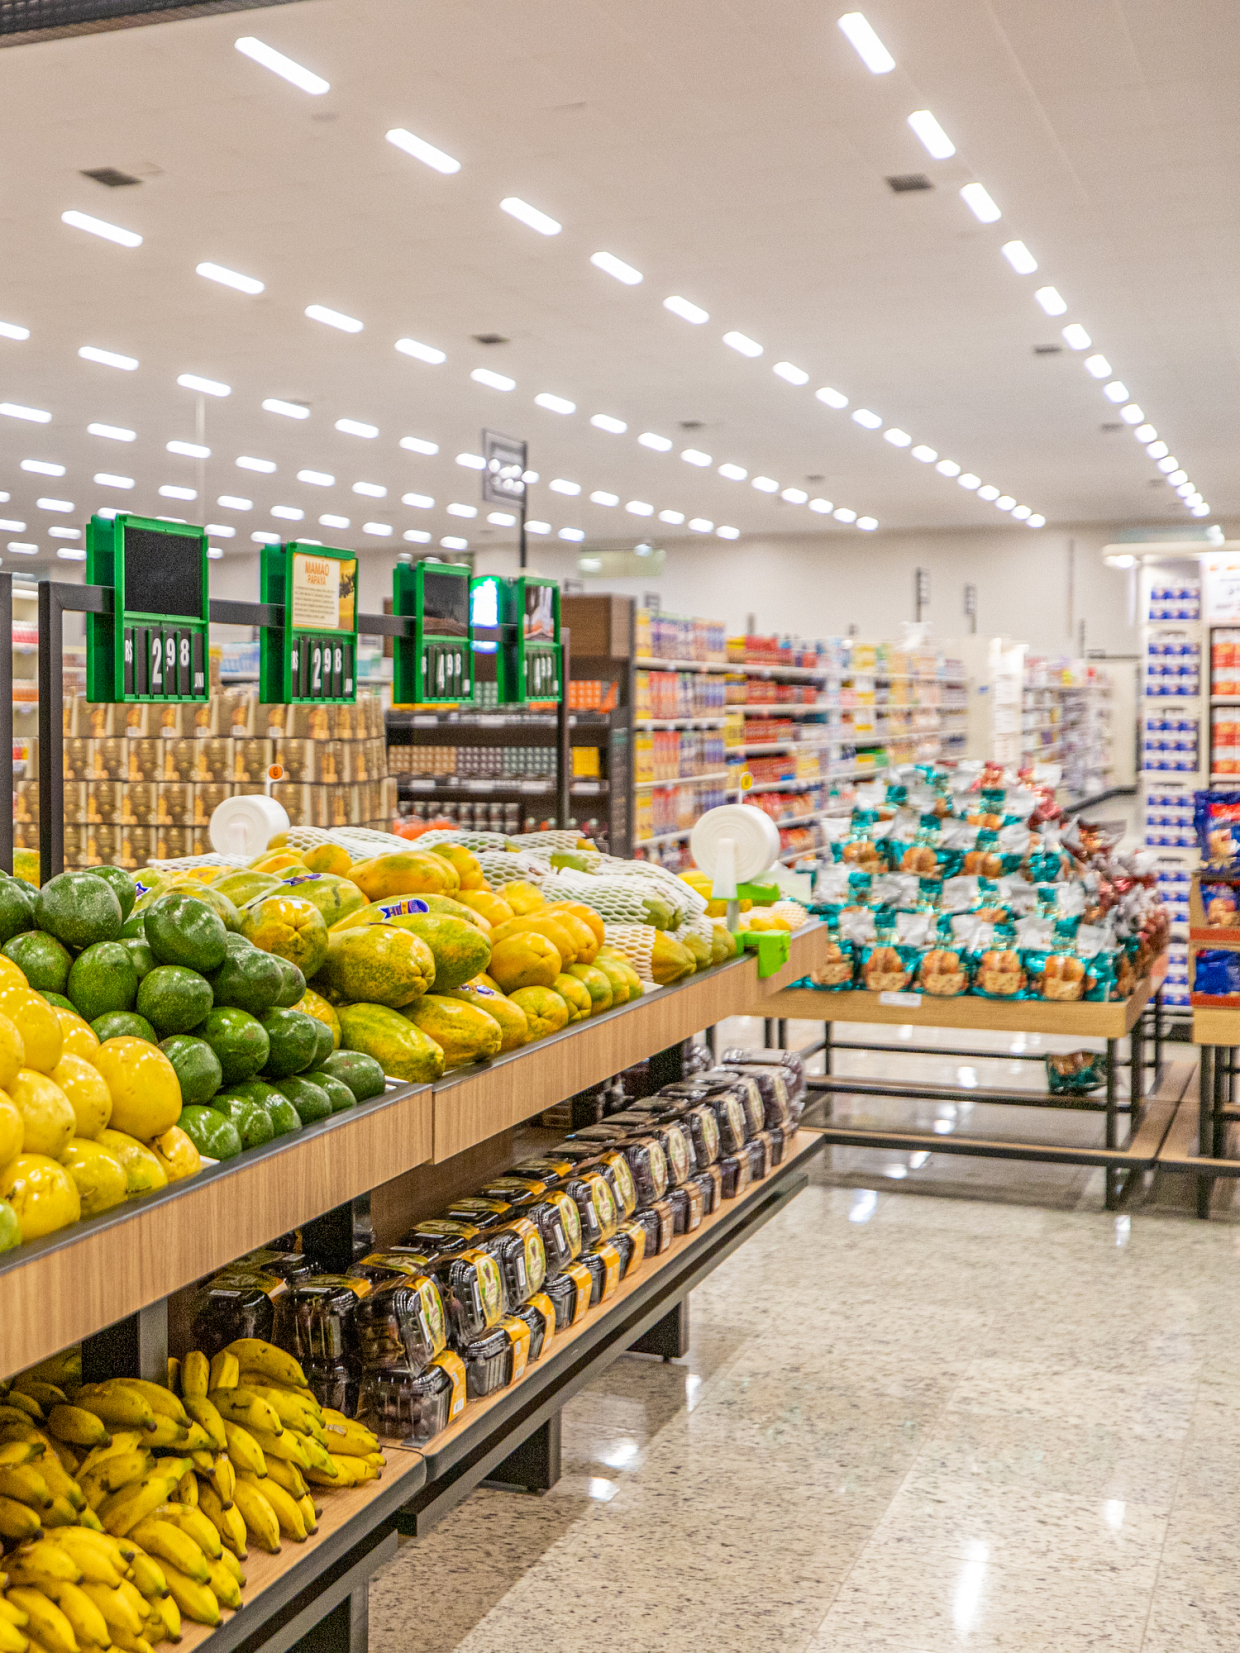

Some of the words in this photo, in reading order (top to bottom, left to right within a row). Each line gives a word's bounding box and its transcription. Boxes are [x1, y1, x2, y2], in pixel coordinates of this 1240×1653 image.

[304, 558, 330, 577] MAMÃO
[307, 574, 326, 586] PAPAYA
[124, 639, 133, 664] R$
